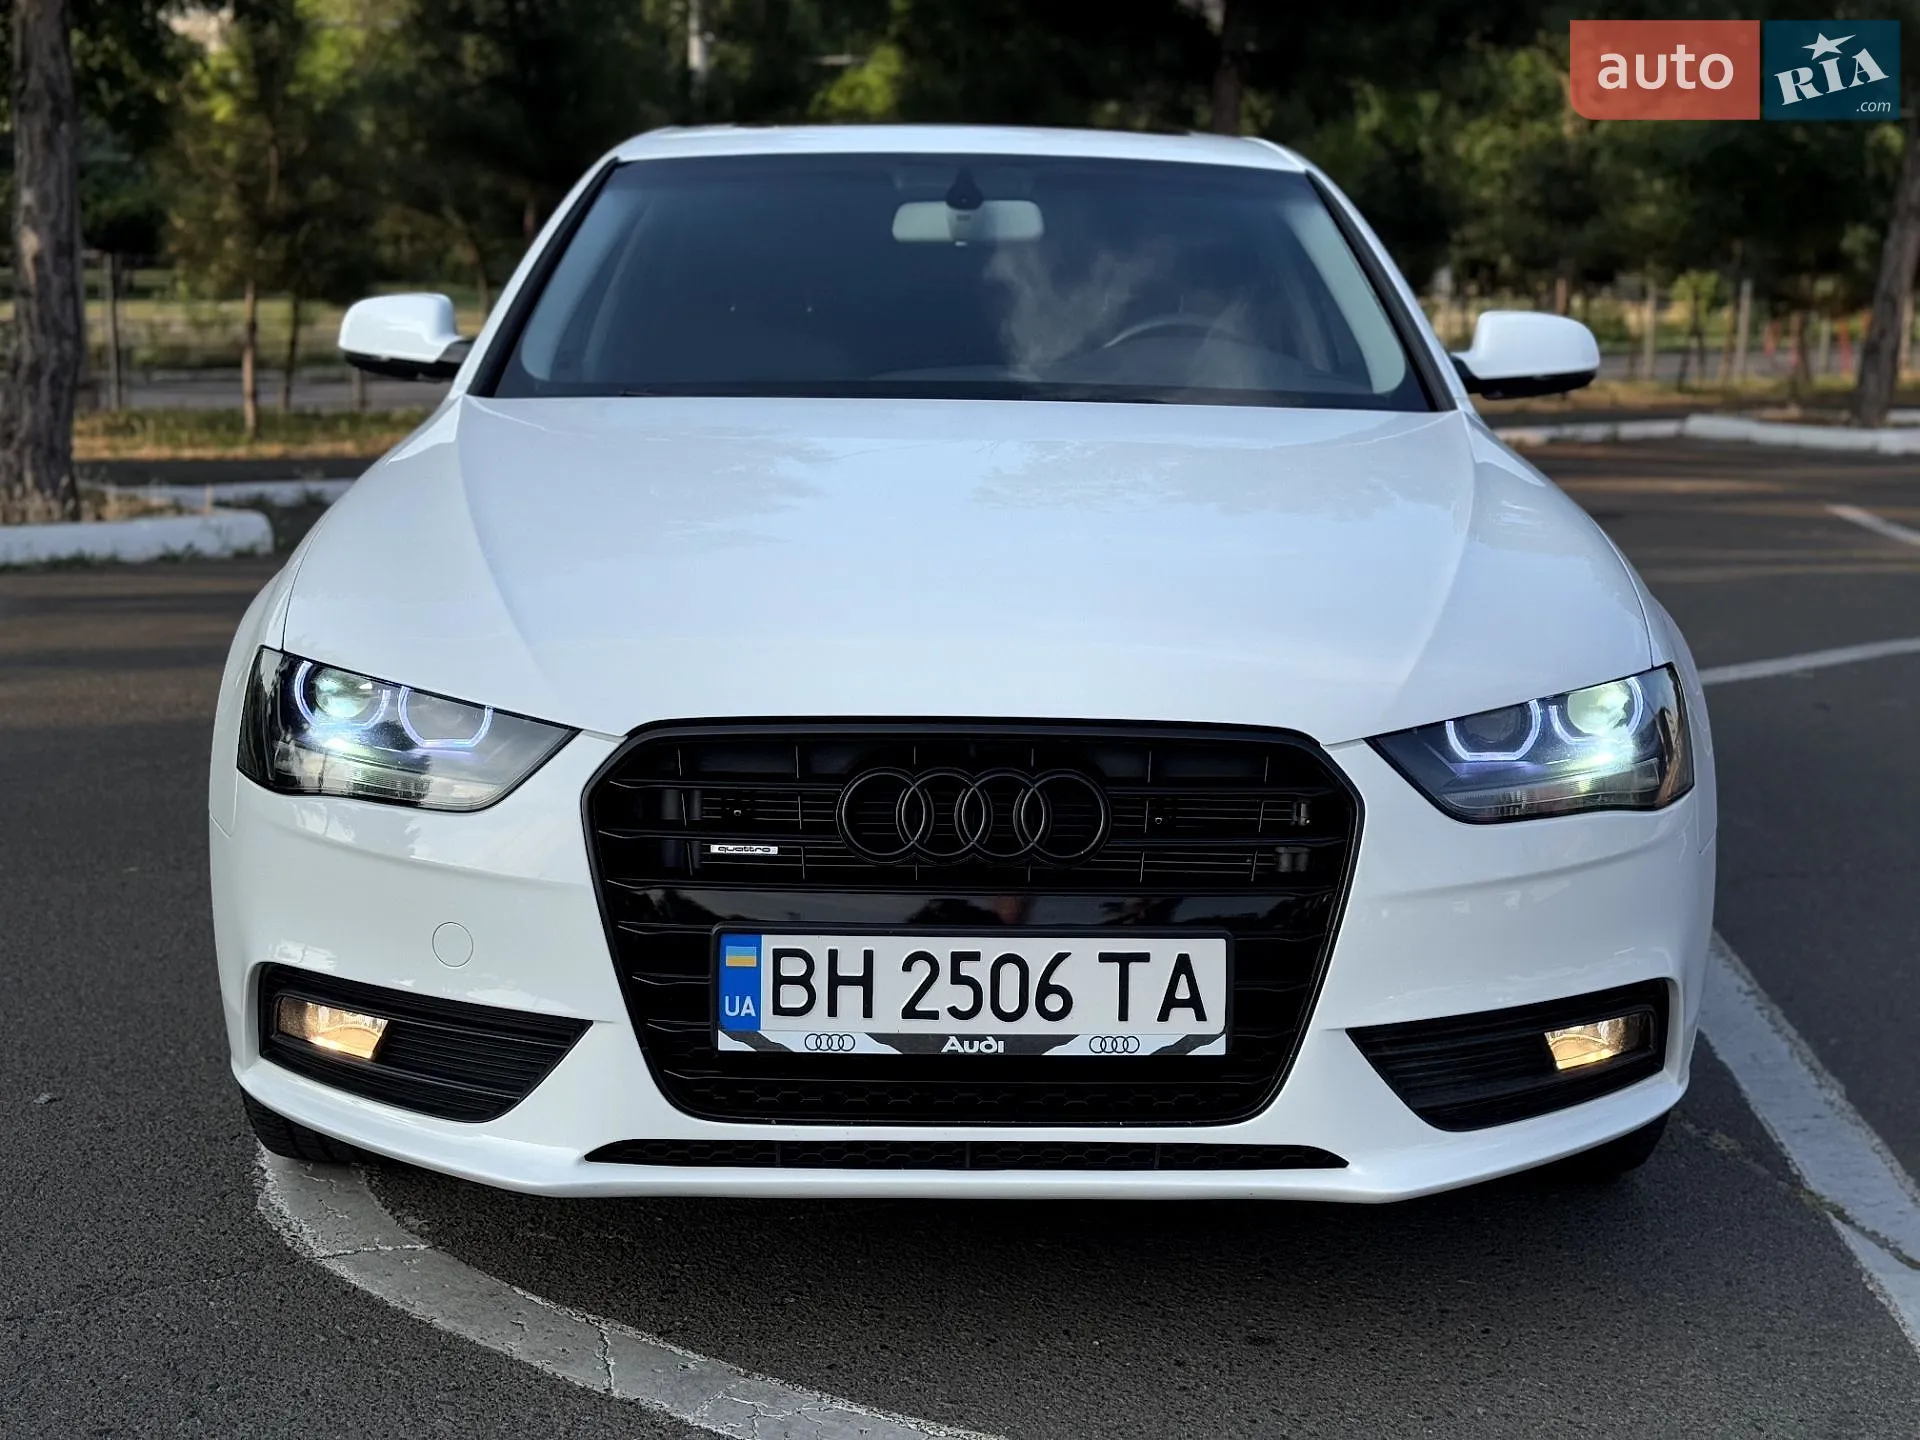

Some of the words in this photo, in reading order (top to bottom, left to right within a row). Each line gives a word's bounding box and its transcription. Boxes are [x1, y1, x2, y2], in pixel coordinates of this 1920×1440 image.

[771, 948, 874, 1019] BH
[901, 951, 1074, 1022] 2506
[1098, 952, 1208, 1022] TA
[724, 995, 756, 1017] UA
[941, 1035, 1005, 1054] Audi
